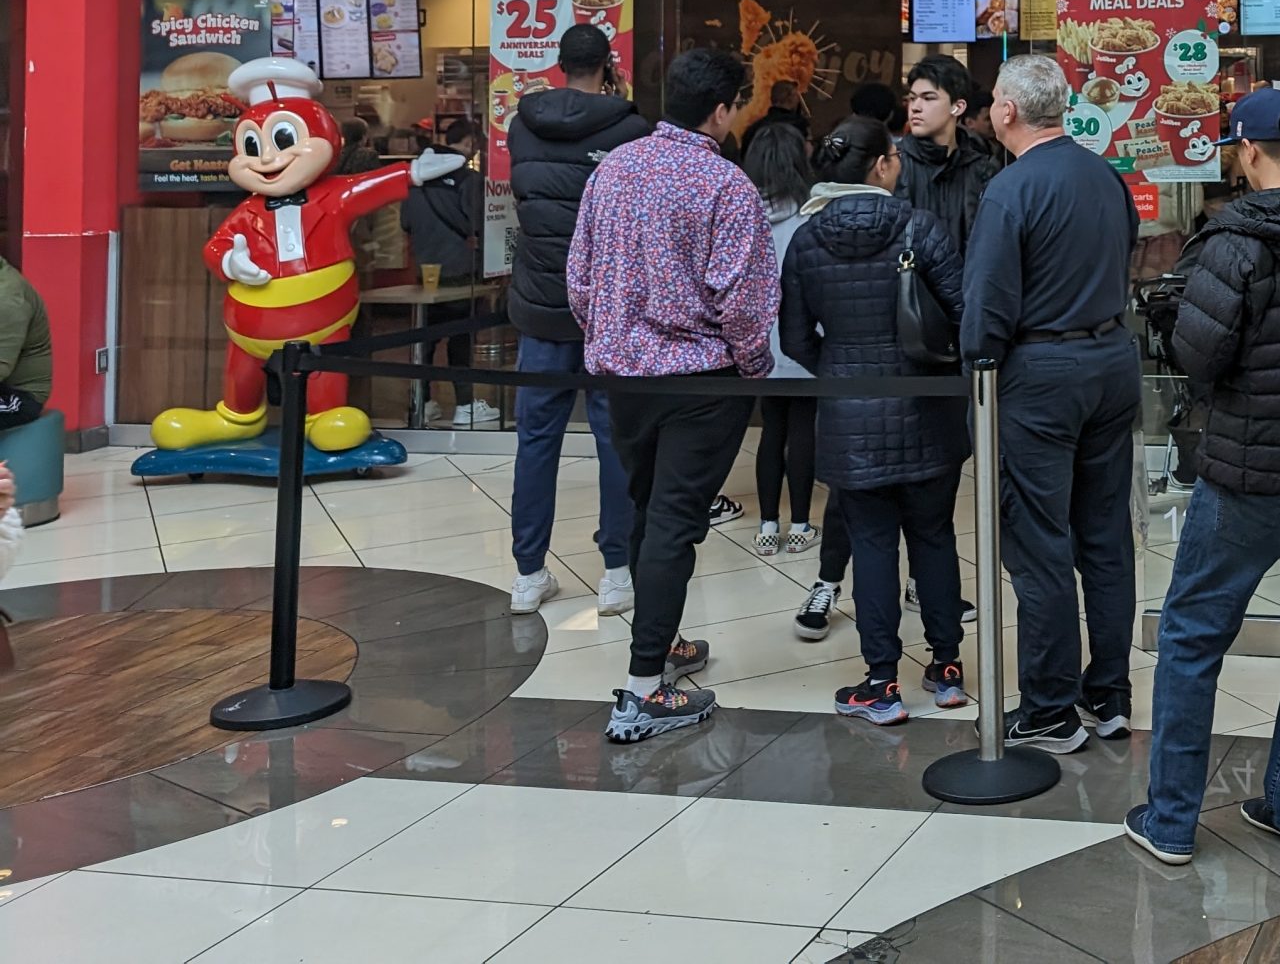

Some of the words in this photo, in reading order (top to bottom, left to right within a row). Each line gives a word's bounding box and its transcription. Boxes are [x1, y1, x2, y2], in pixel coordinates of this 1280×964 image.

[151, 16, 194, 37] Spicy
[196, 11, 261, 32] Chicken
[168, 31, 242, 48] Sandwich
[517, 50, 545, 59] DEALS
[1172, 41, 1208, 62] $28
[1065, 116, 1101, 137] $30
[1134, 120, 1156, 130] Peac
[1136, 144, 1162, 156] Peach
[154, 173, 168, 183] Feel
[169, 173, 181, 183] the
[486, 180, 512, 198] Now
[1132, 193, 1154, 201] carts
